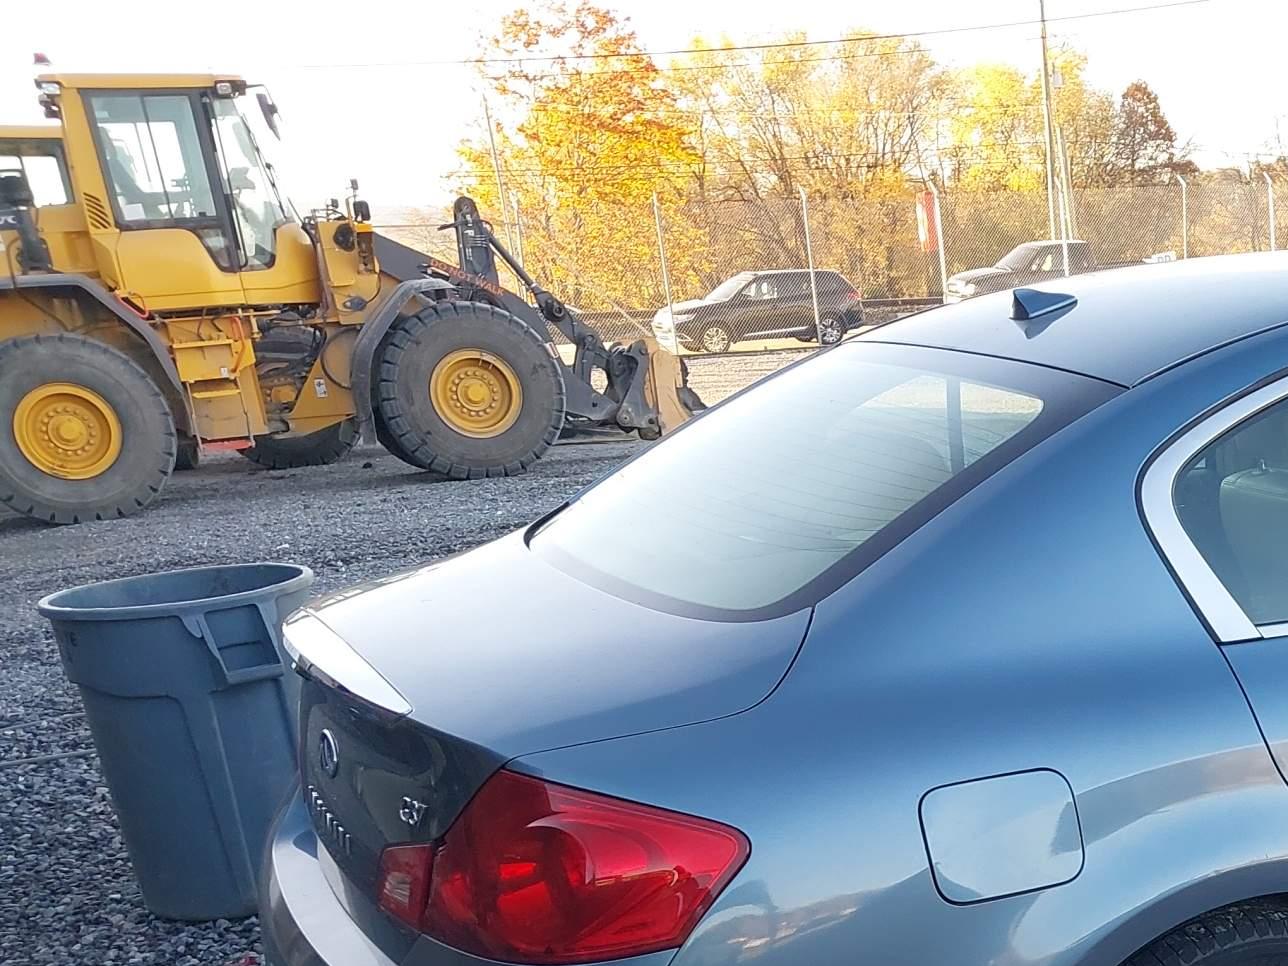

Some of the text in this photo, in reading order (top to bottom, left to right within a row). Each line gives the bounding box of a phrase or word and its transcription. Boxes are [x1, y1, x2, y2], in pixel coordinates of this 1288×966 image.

[430, 259, 504, 296] DO NOT WALK
